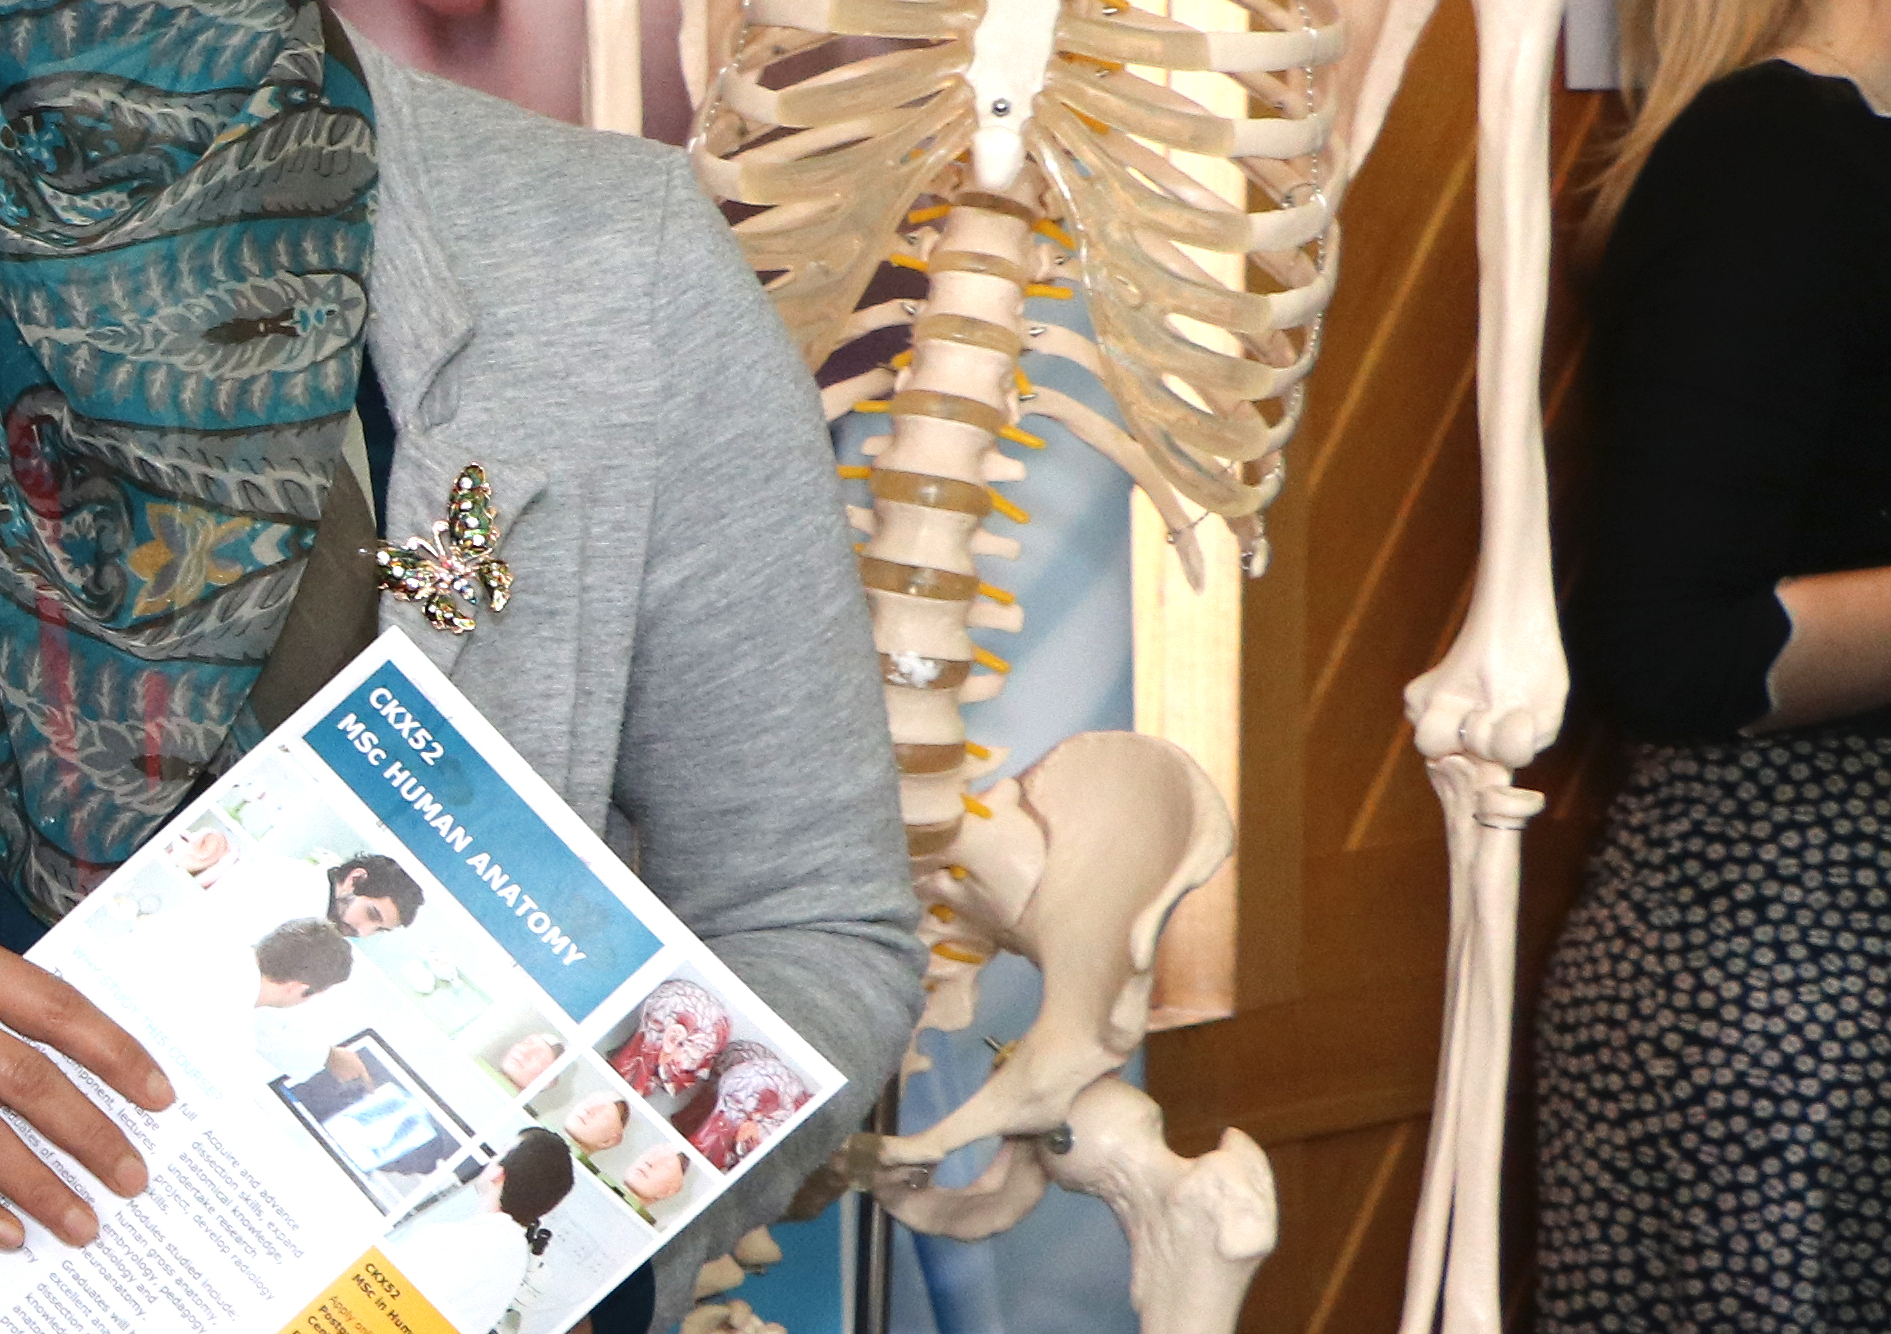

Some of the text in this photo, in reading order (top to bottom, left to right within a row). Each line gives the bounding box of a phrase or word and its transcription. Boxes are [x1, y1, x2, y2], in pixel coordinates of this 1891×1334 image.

[368, 686, 446, 765] CKX52
[336, 713, 586, 967] MSc HUMAN ANATOMY
[39, 1145, 55, 1161] of
[114, 1106, 162, 1156] lectures,
[165, 1160, 260, 1259] undertake research
[177, 1149, 288, 1267] anatomical knowledge,
[189, 1138, 305, 1261] dissection skills, expand
[200, 1126, 302, 1232] Acquire and advance
[98, 1220, 163, 1287] embryology,
[112, 1209, 222, 1327] human gross anatomy,
[124, 1198, 168, 1244] Modules
[163, 1240, 204, 1281] studied
[190, 1211, 233, 1256] develop
[227, 1251, 277, 1303] radiology
[35, 1280, 86, 1333] dissection
[46, 1268, 94, 1318] excellent
[59, 1257, 113, 1313] Graduates
[108, 1309, 131, 1332] will
[134, 1280, 159, 1305] and
[326, 1293, 357, 1325] Apply
[350, 1272, 377, 1299] MSc
[373, 1296, 389, 1311] in
[362, 1260, 402, 1301] CKX52
